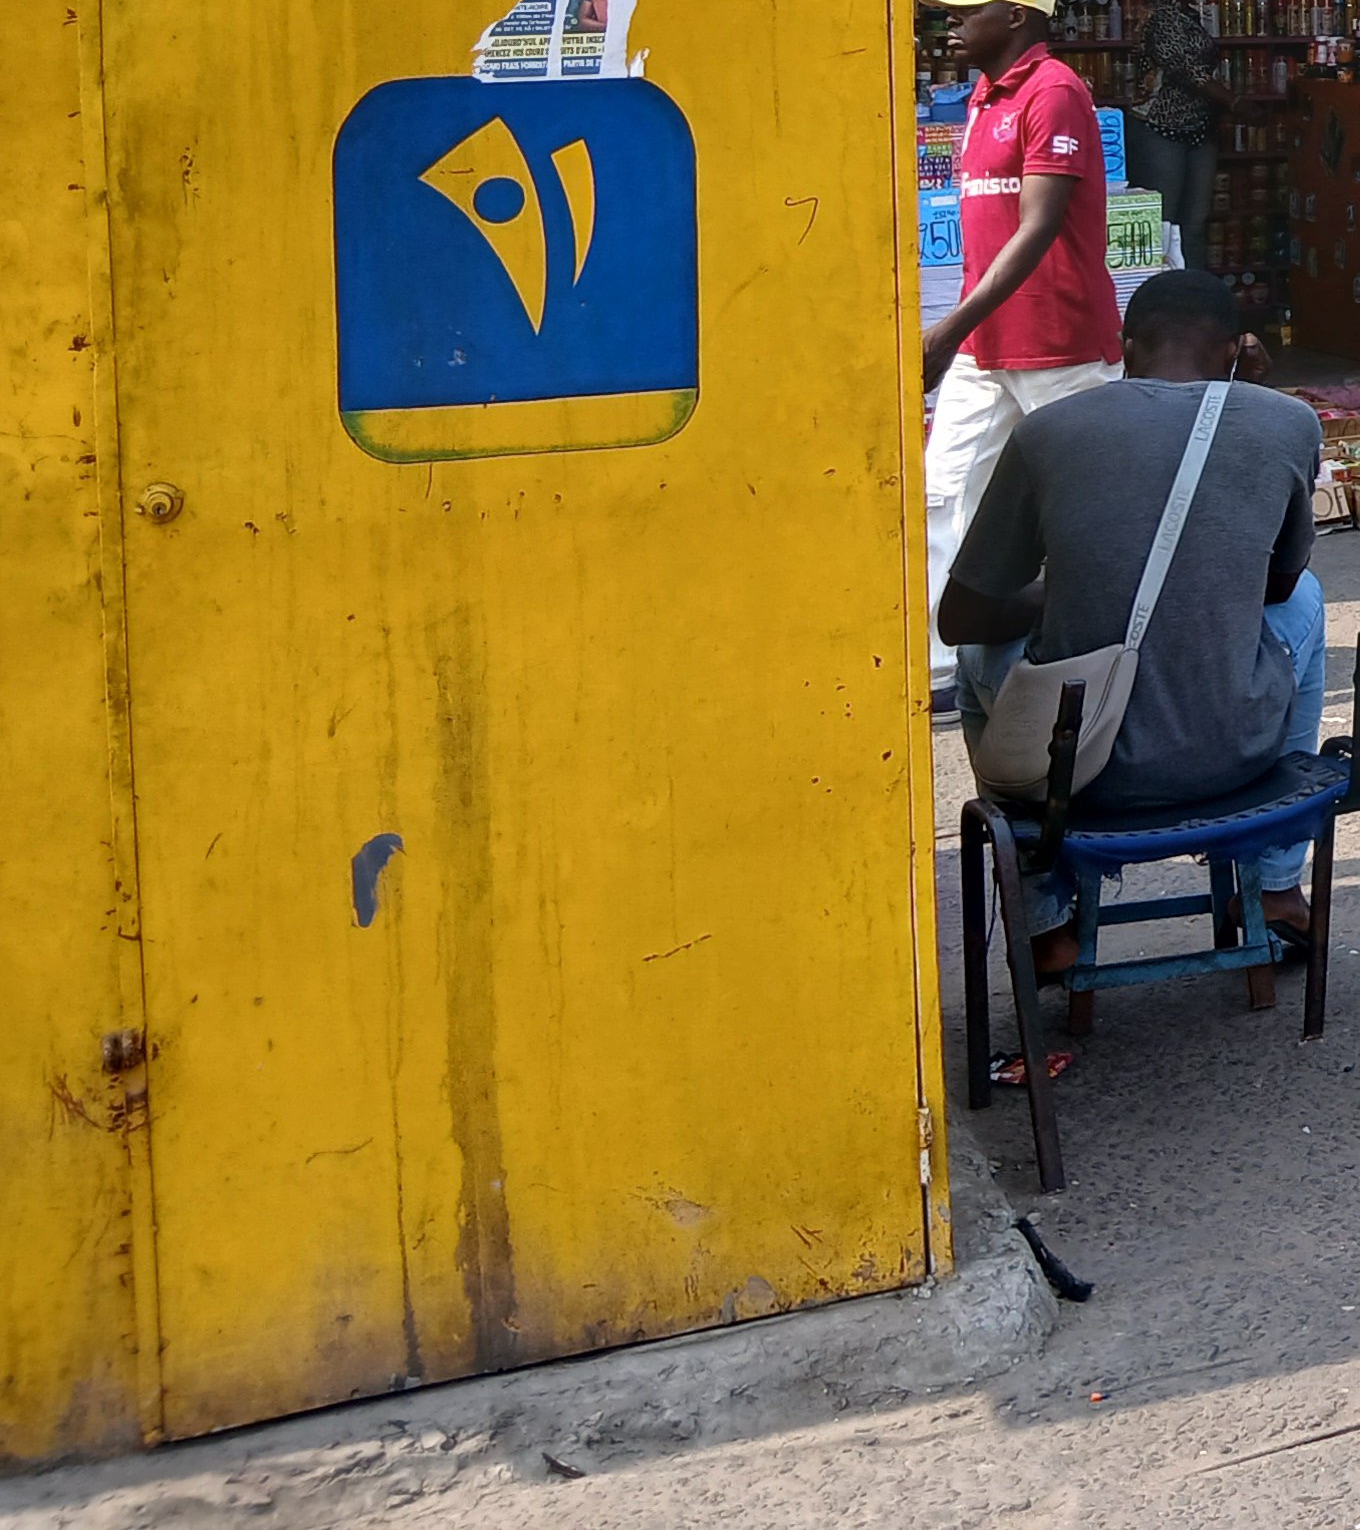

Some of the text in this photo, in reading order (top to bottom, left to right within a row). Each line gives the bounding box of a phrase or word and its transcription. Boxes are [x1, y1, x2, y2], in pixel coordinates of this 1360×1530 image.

[1052, 135, 1080, 155] SF
[919, 220, 962, 260] 250
[1194, 393, 1222, 444] LACOSTE
